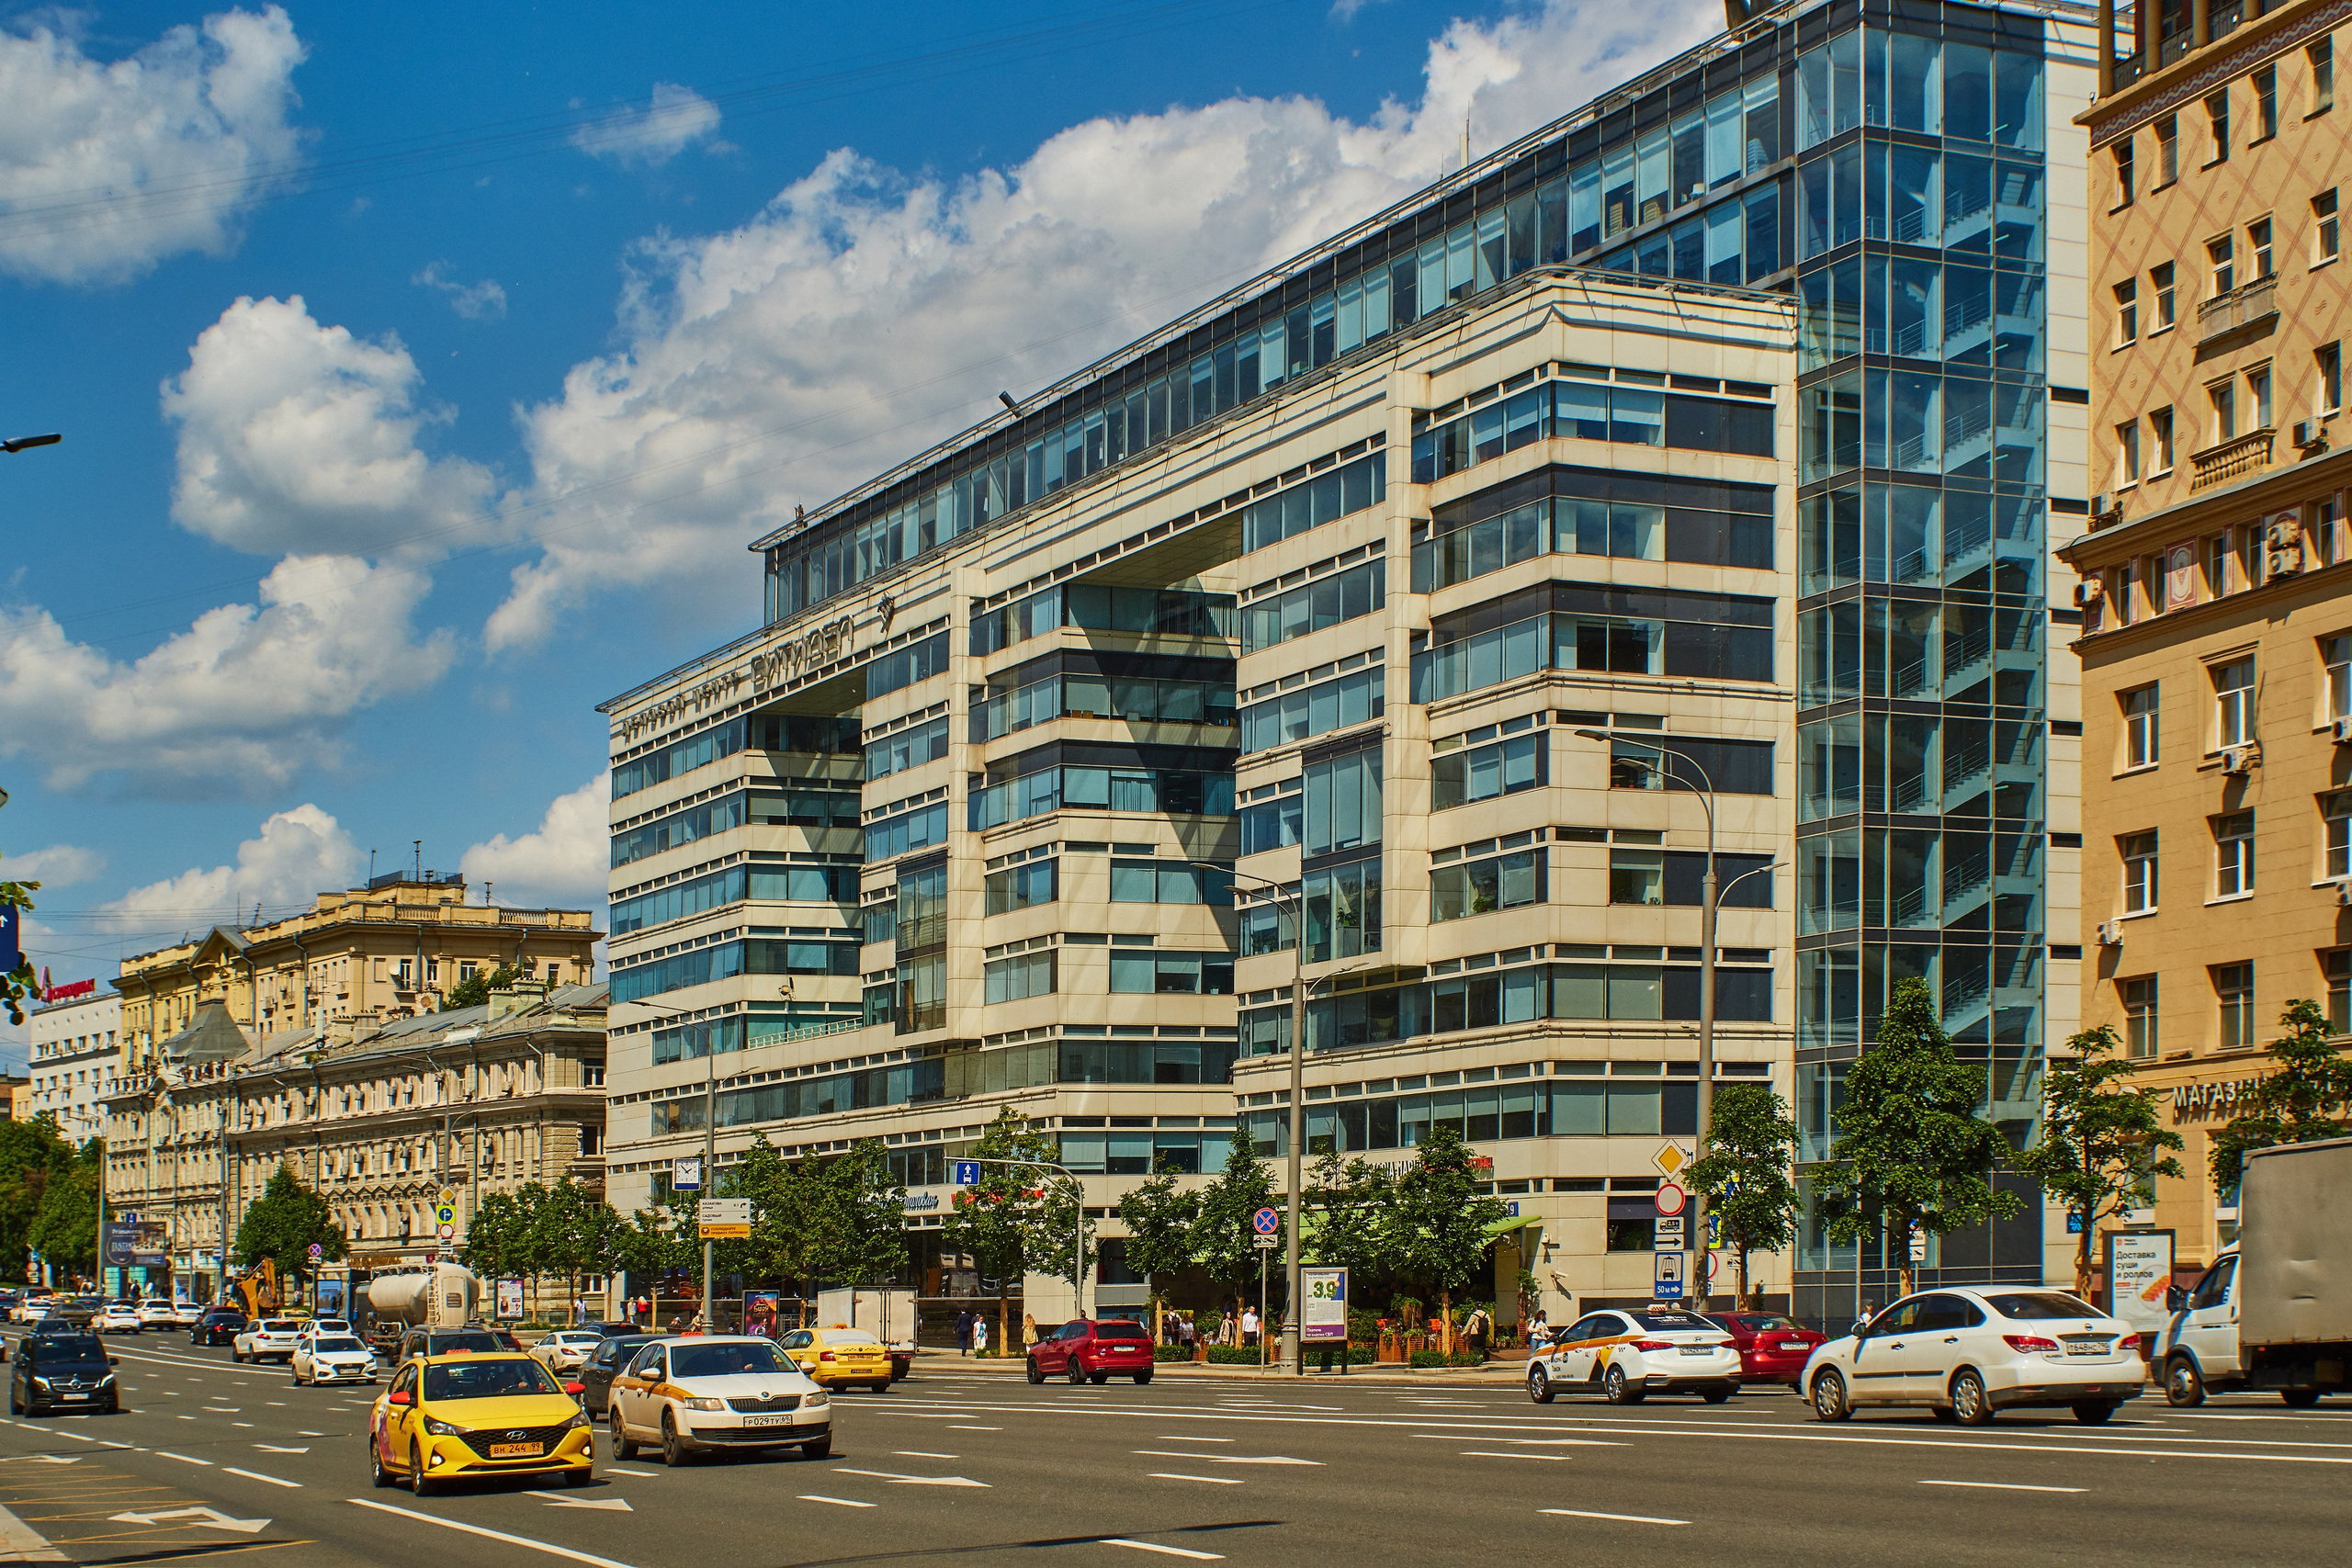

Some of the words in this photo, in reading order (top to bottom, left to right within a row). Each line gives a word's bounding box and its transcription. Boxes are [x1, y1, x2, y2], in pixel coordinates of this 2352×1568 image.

[1510, 1204, 1515, 1215] 9
[2116, 1251, 2156, 1260] Доставка
[2116, 1262, 2138, 1270] суши
[2123, 1271, 2154, 1280] роллов
[1313, 1280, 1337, 1299] 3,9
[1657, 1285, 1665, 1293] 50
[509, 1444, 526, 1453] 244
